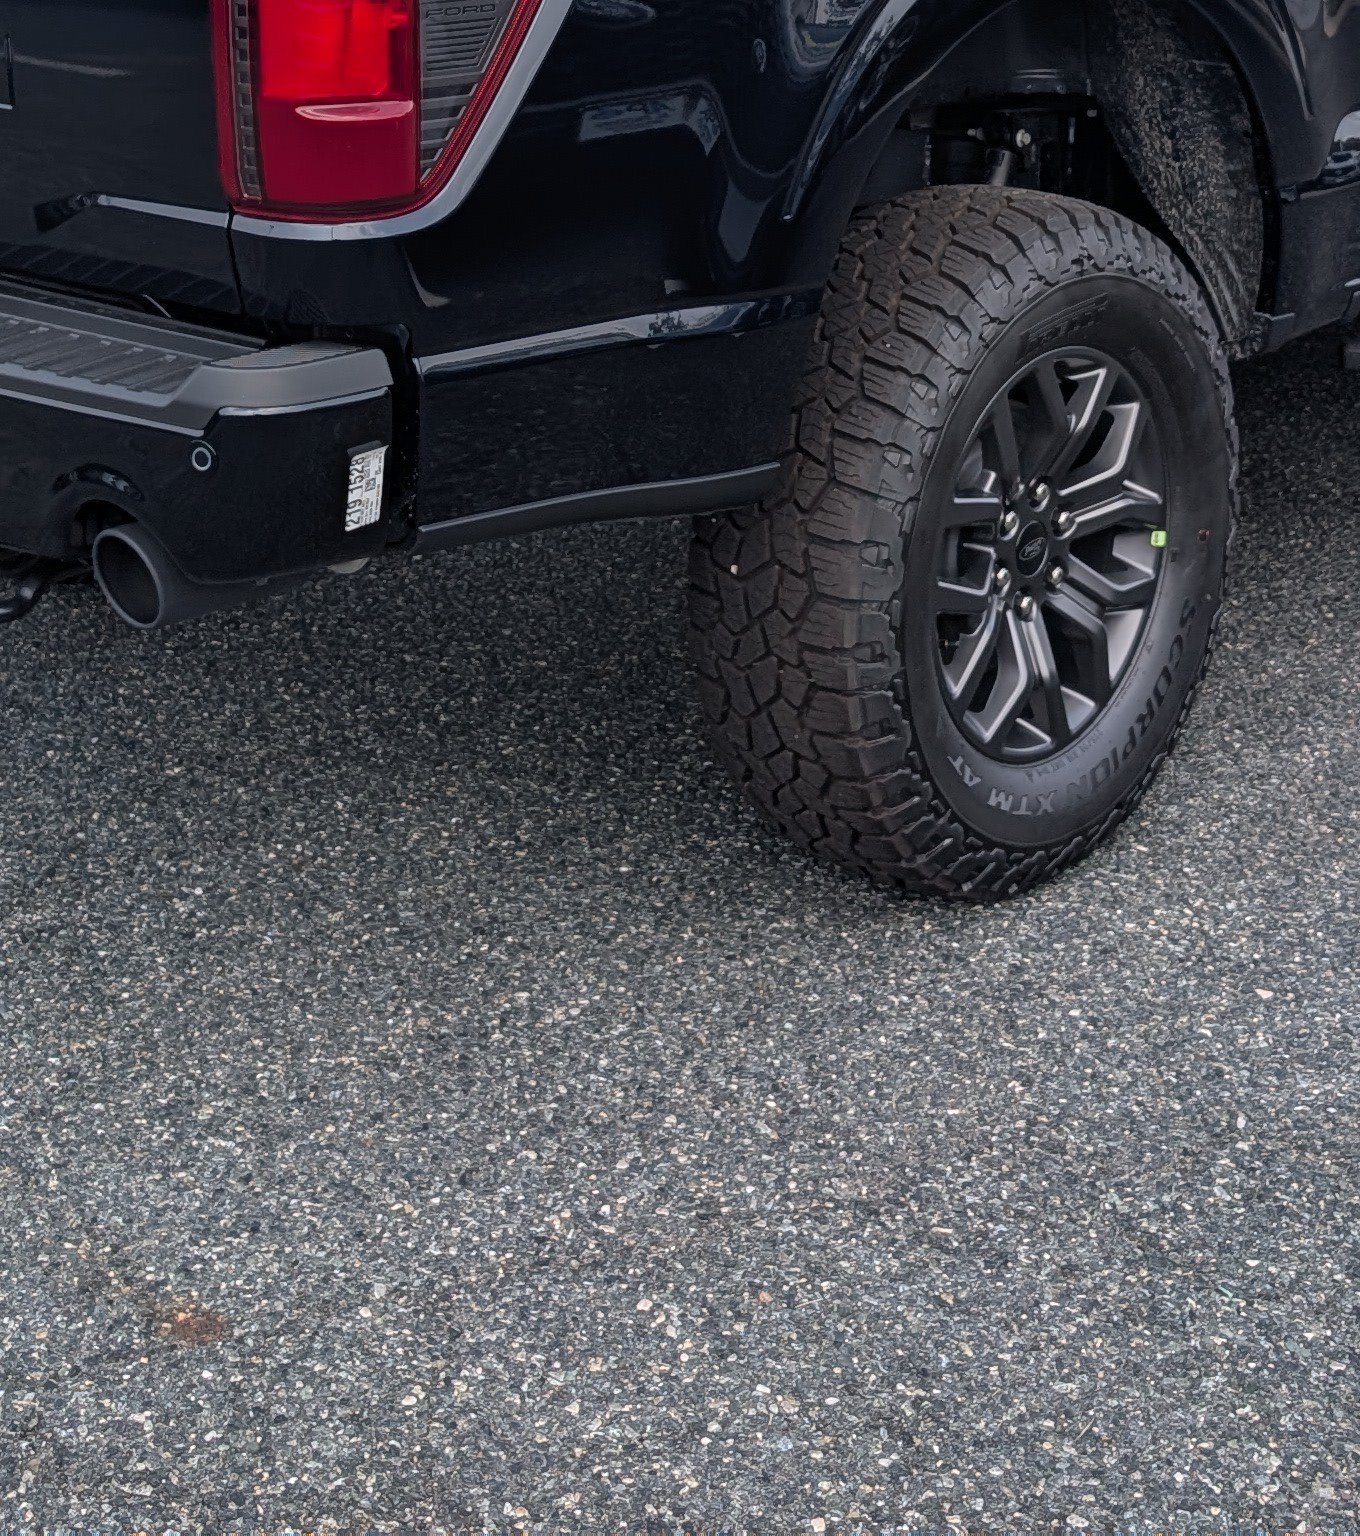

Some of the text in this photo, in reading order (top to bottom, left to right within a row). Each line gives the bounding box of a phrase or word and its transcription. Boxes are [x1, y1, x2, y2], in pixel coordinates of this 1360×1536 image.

[425, 4, 496, 19] FORD
[1067, 596, 1197, 802] SCORPION
[946, 754, 983, 788] AT
[987, 785, 1058, 815] XTM
